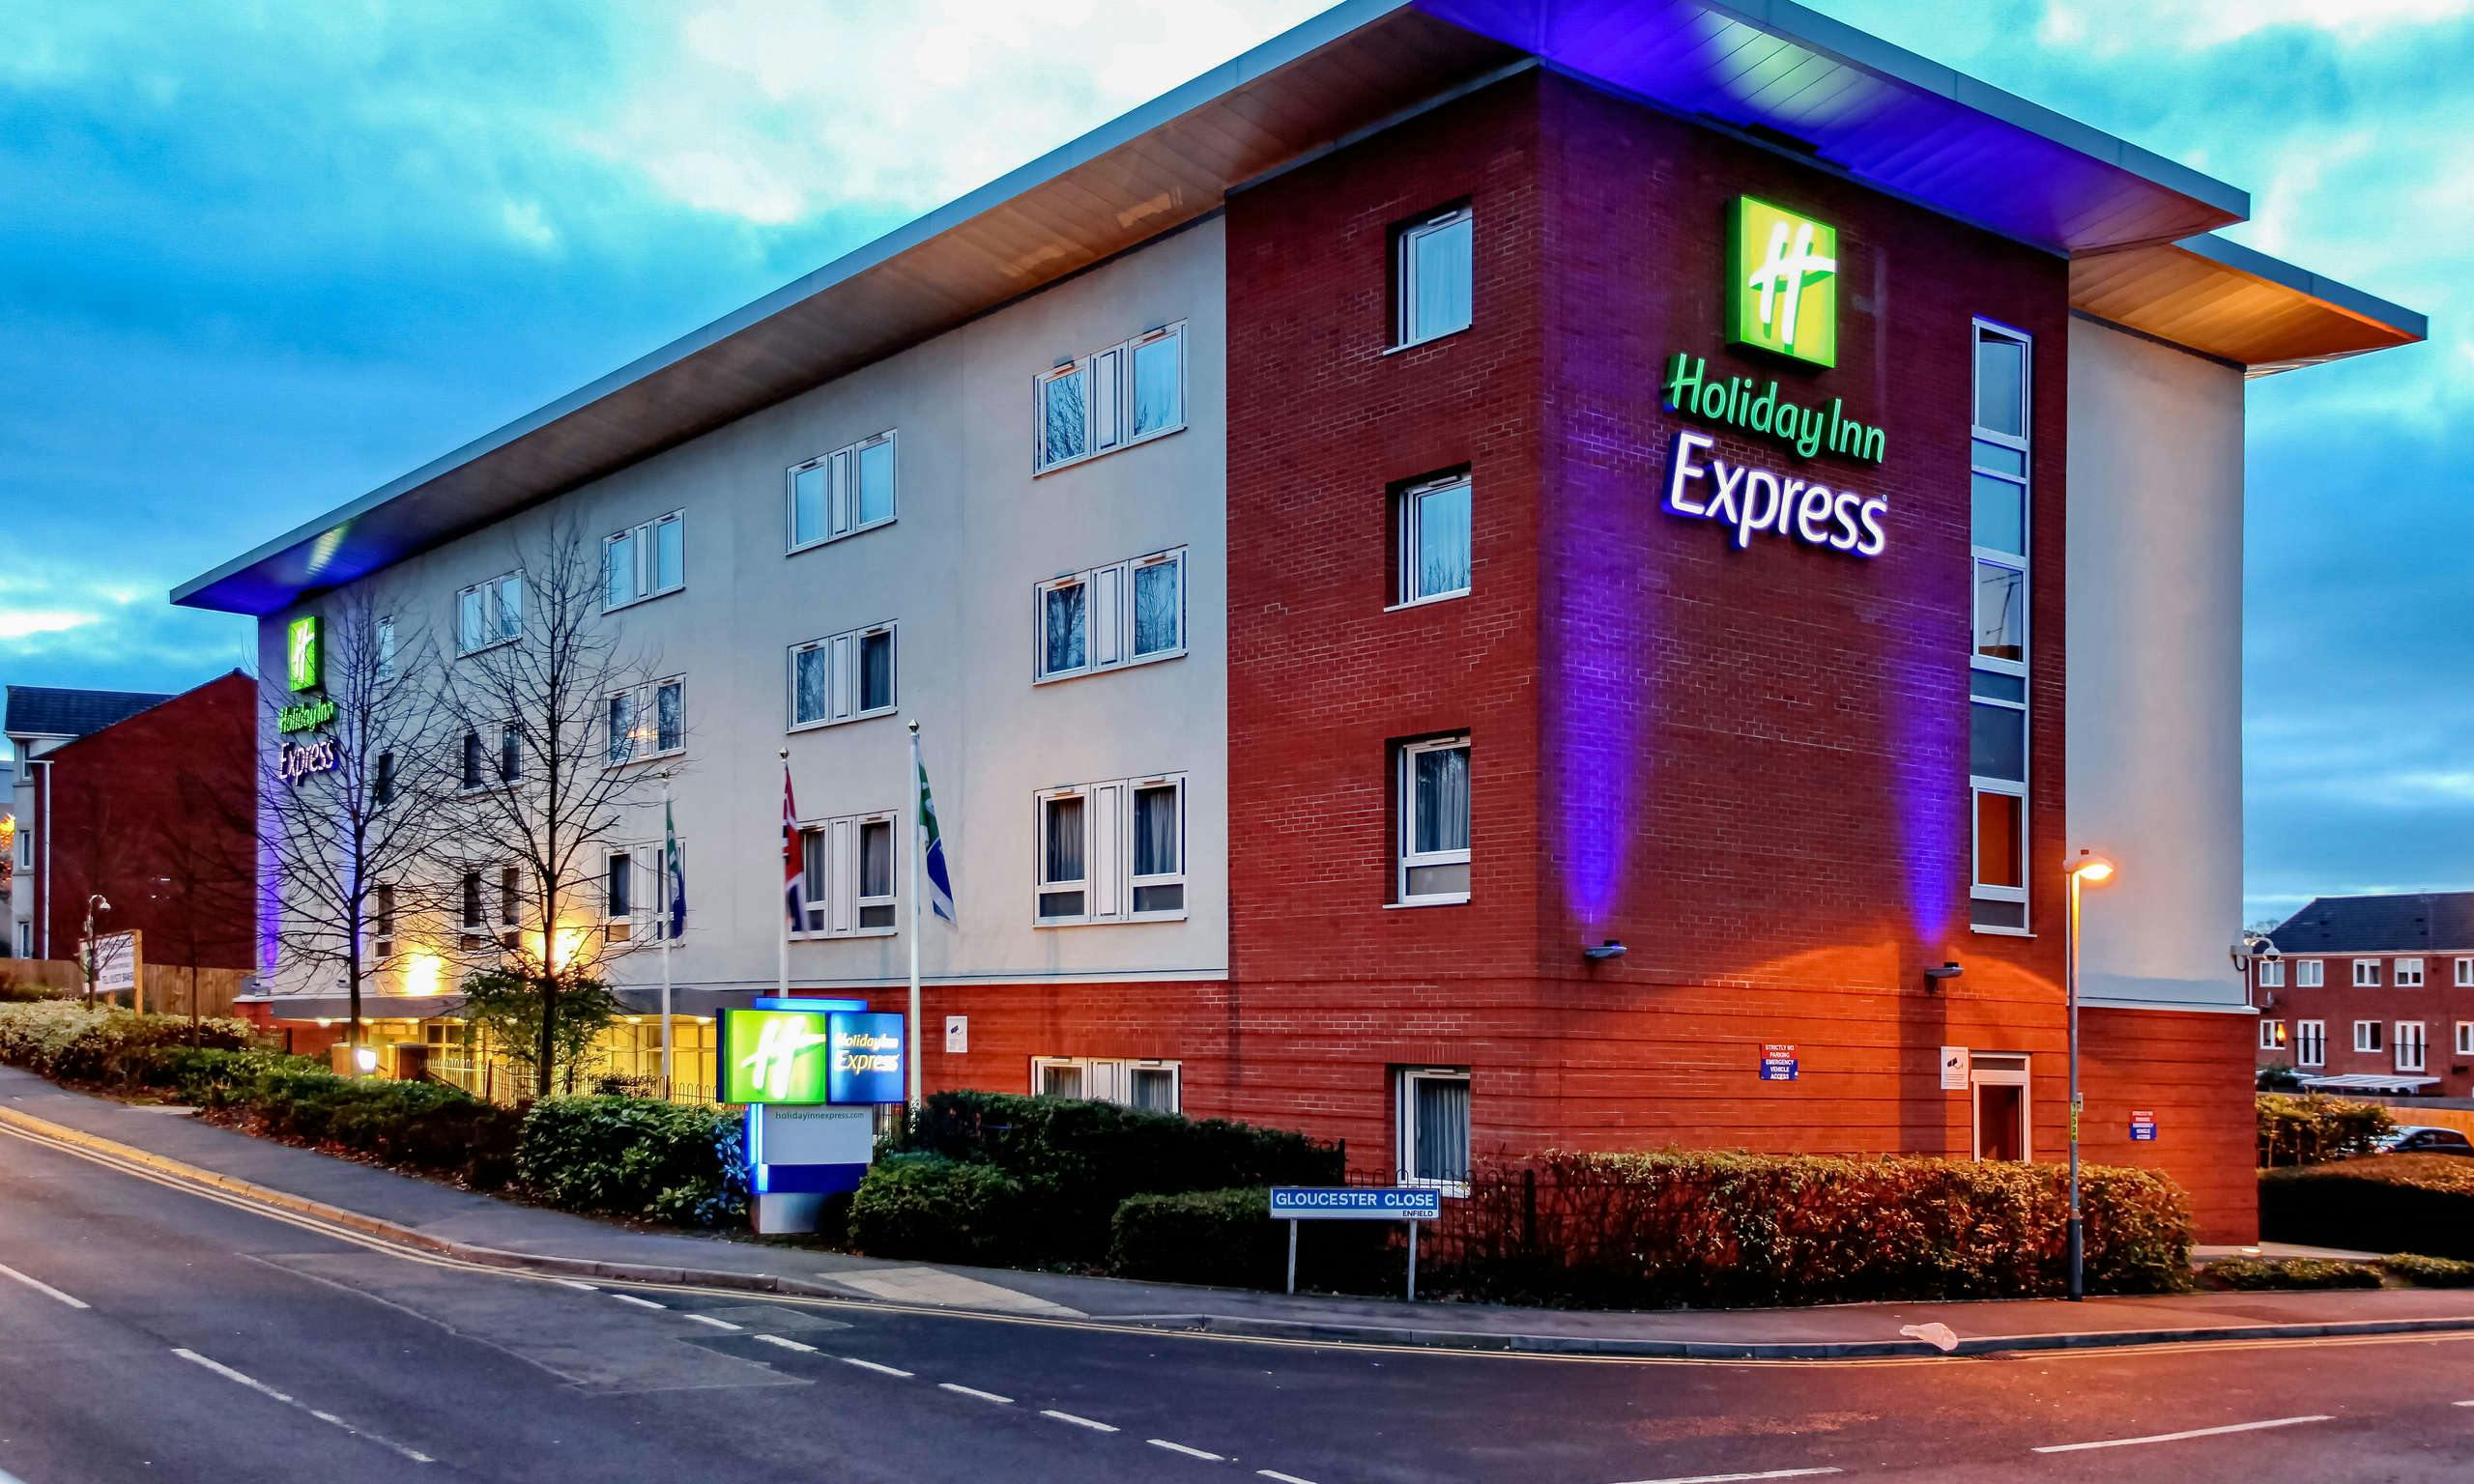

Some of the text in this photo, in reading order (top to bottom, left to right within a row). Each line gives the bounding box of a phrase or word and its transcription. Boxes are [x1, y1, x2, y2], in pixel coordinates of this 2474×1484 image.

[1668, 352, 1886, 464] Holiday Inn
[1669, 431, 1887, 557] Express
[278, 698, 333, 734] Holiday Inn
[278, 739, 334, 786] Express
[775, 1111, 865, 1122] holidayinnexpress.com
[1276, 1192, 1434, 1207] GLOUCESTER CLOSE
